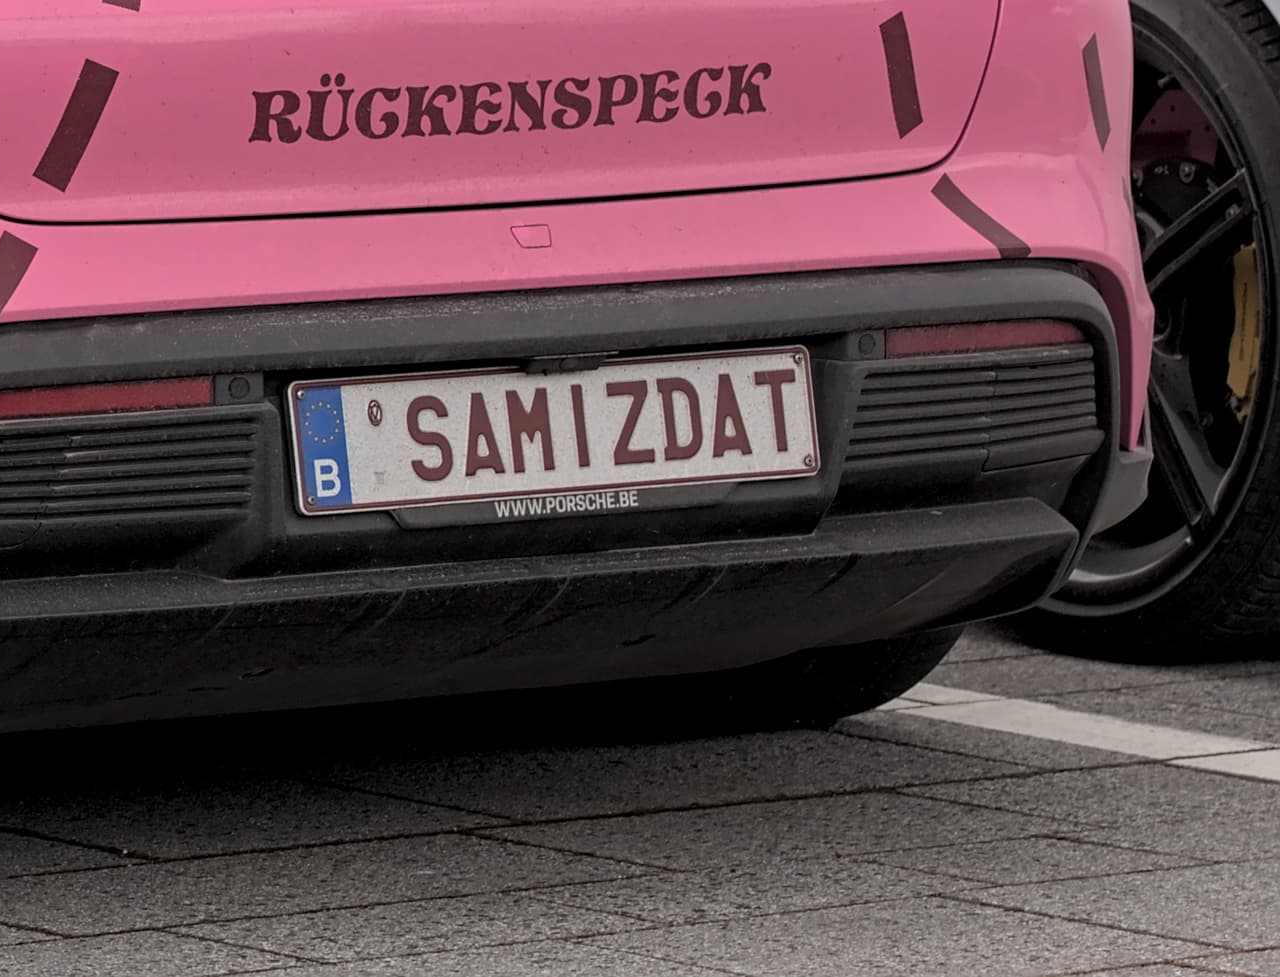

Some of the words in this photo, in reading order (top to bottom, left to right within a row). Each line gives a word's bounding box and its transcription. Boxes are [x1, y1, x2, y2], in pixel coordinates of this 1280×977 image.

[248, 62, 772, 144] RÜCKENSPECK
[406, 368, 796, 482] SAMIZDAT
[314, 458, 342, 498] B
[494, 490, 639, 518] WWW.PORSCHE.BE
